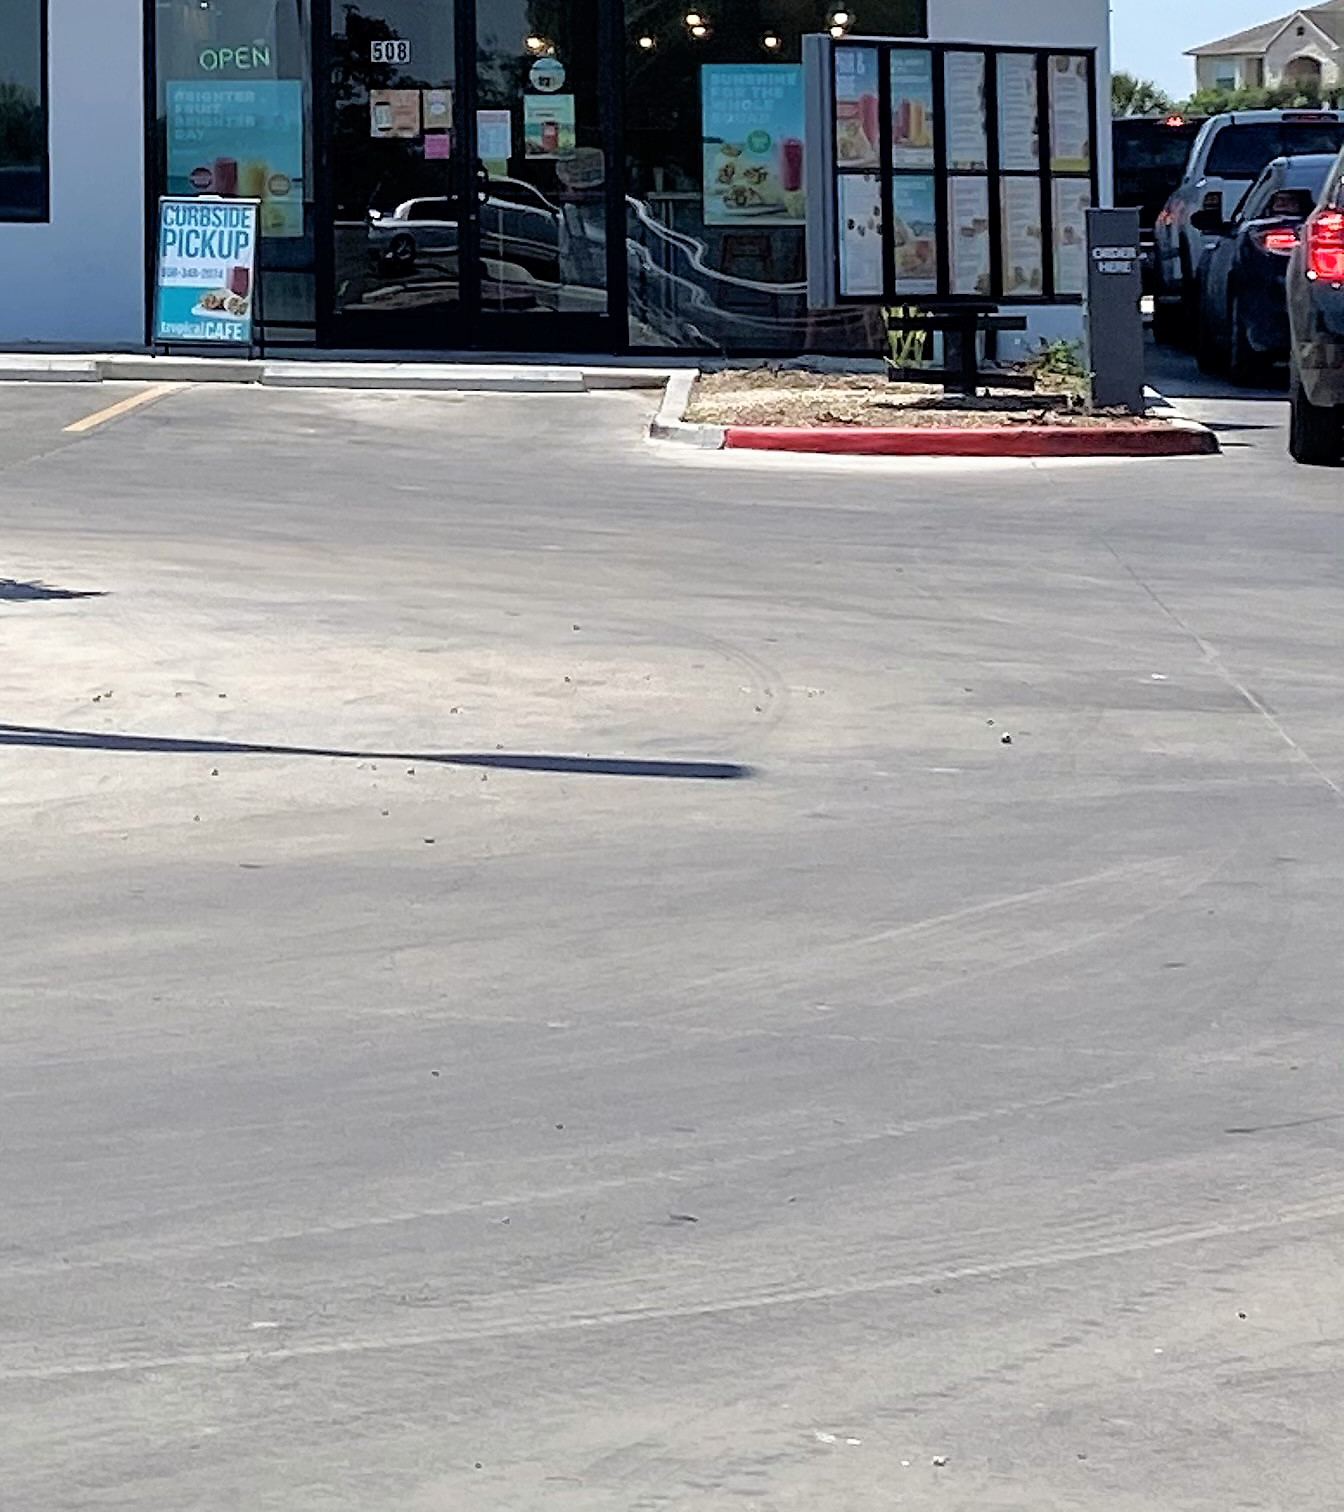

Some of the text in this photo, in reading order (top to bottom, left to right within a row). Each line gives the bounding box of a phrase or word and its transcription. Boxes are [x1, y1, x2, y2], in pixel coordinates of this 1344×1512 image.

[199, 46, 271, 71] OPEN
[372, 42, 407, 61] 508
[163, 206, 251, 229] CURBSIDE
[162, 228, 250, 259] PICKUP
[207, 321, 243, 340] CAFE
